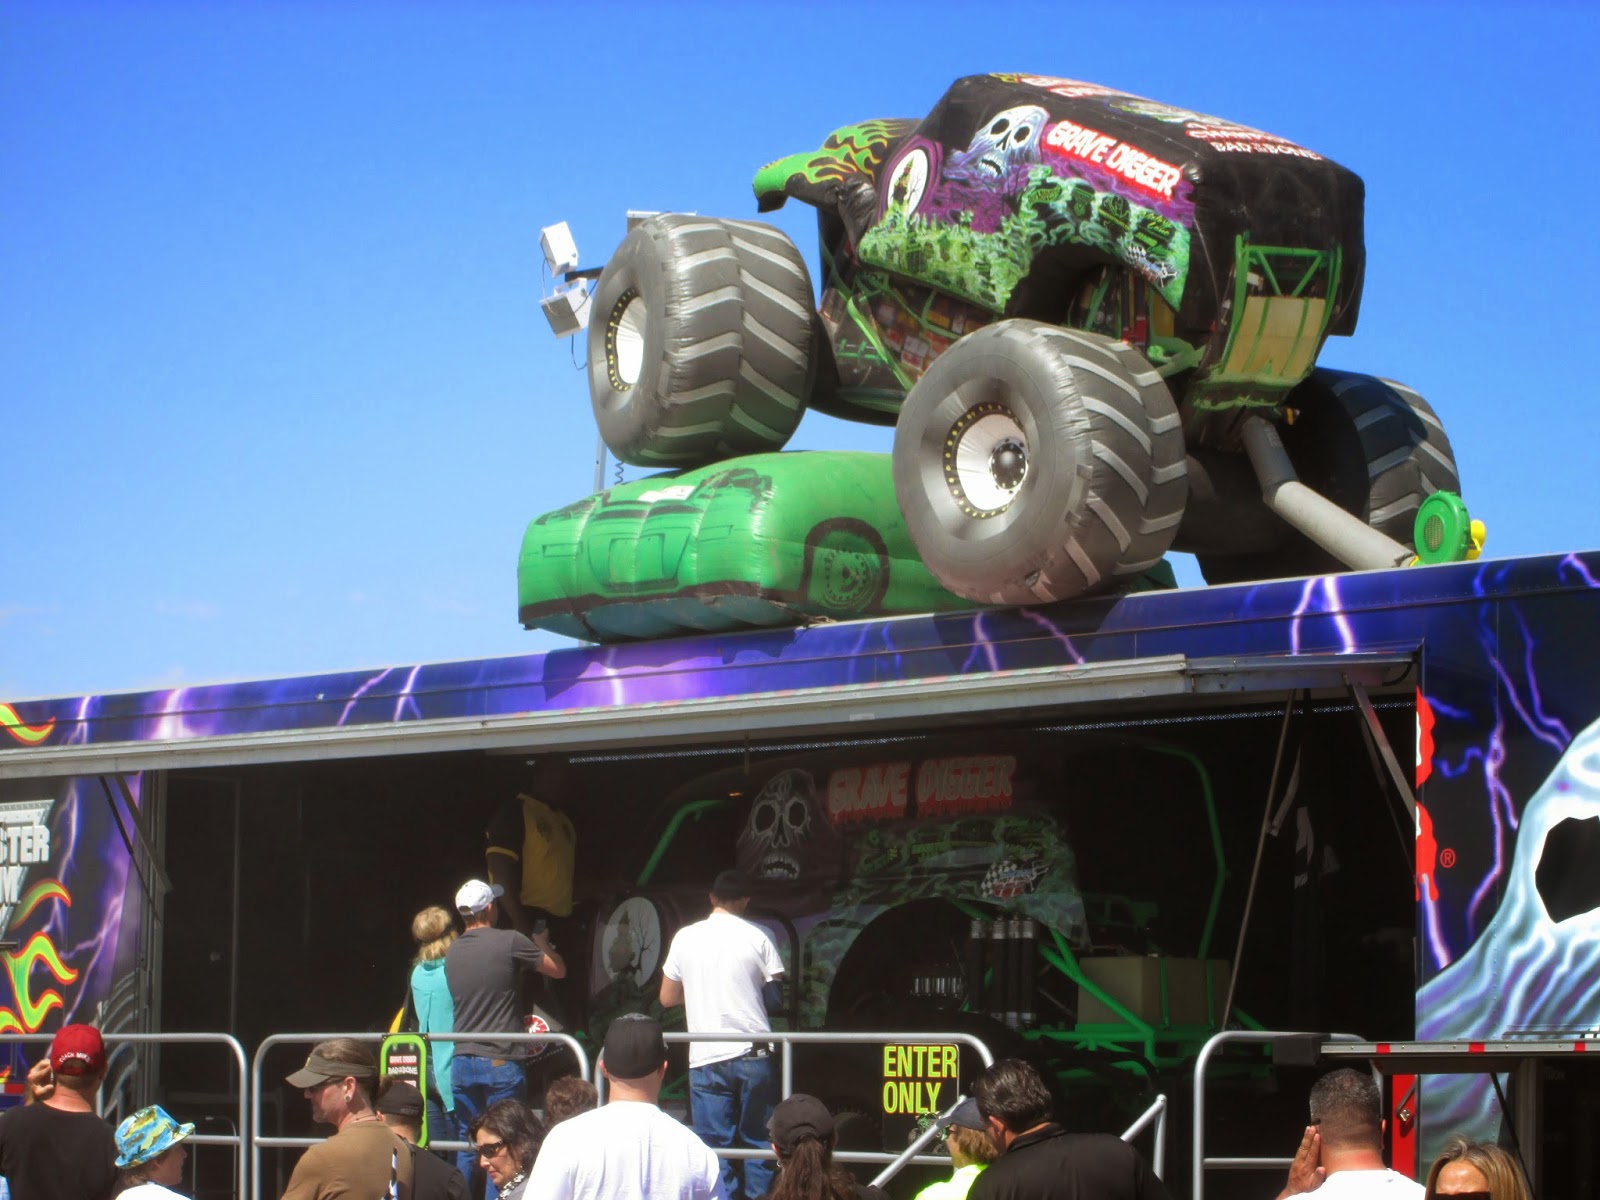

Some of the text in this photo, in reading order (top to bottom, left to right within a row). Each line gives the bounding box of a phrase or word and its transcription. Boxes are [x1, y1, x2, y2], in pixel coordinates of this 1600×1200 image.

[1047, 120, 1181, 197] GRAVE DIGGER
[828, 754, 1018, 815] GRAVE DIGGER
[59, 1052, 75, 1063] COACH
[884, 1046, 957, 1078] ENTER
[883, 1081, 942, 1114] ONLY
